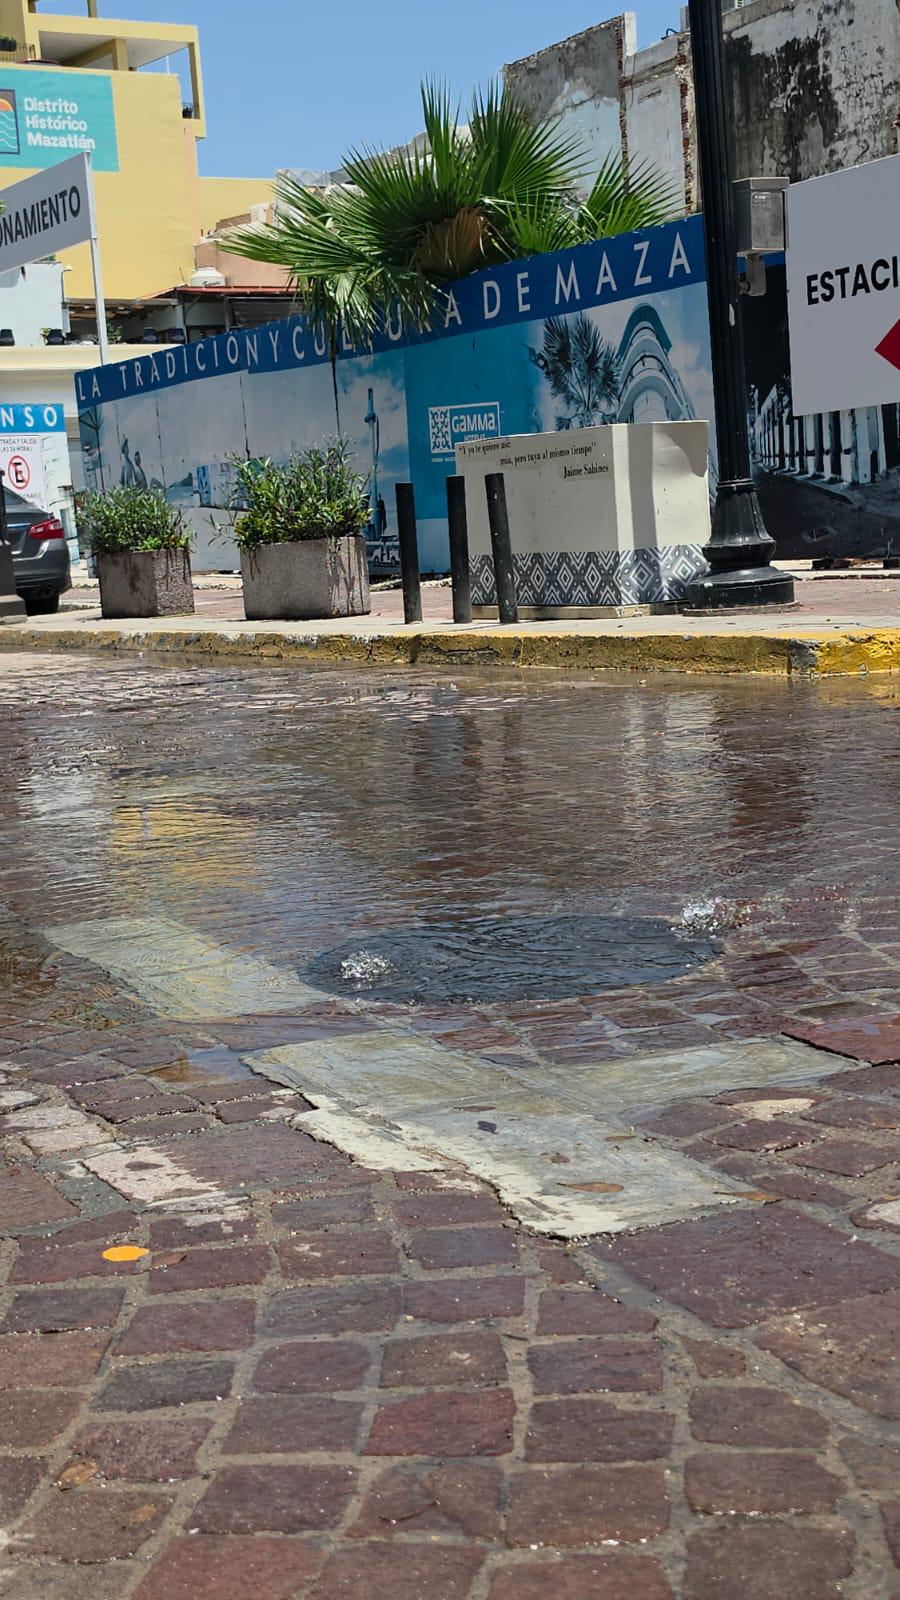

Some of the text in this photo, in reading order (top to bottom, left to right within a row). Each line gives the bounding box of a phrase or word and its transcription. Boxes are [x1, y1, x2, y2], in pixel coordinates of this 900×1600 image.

[24, 97, 78, 114] Distrito
[25, 114, 88, 131] Histórico
[27, 132, 96, 150] Mazatlán
[806, 255, 899, 306] ESTACI
[78, 372, 101, 401] LA
[482, 271, 531, 320] DE
[554, 231, 692, 305] MAZA
